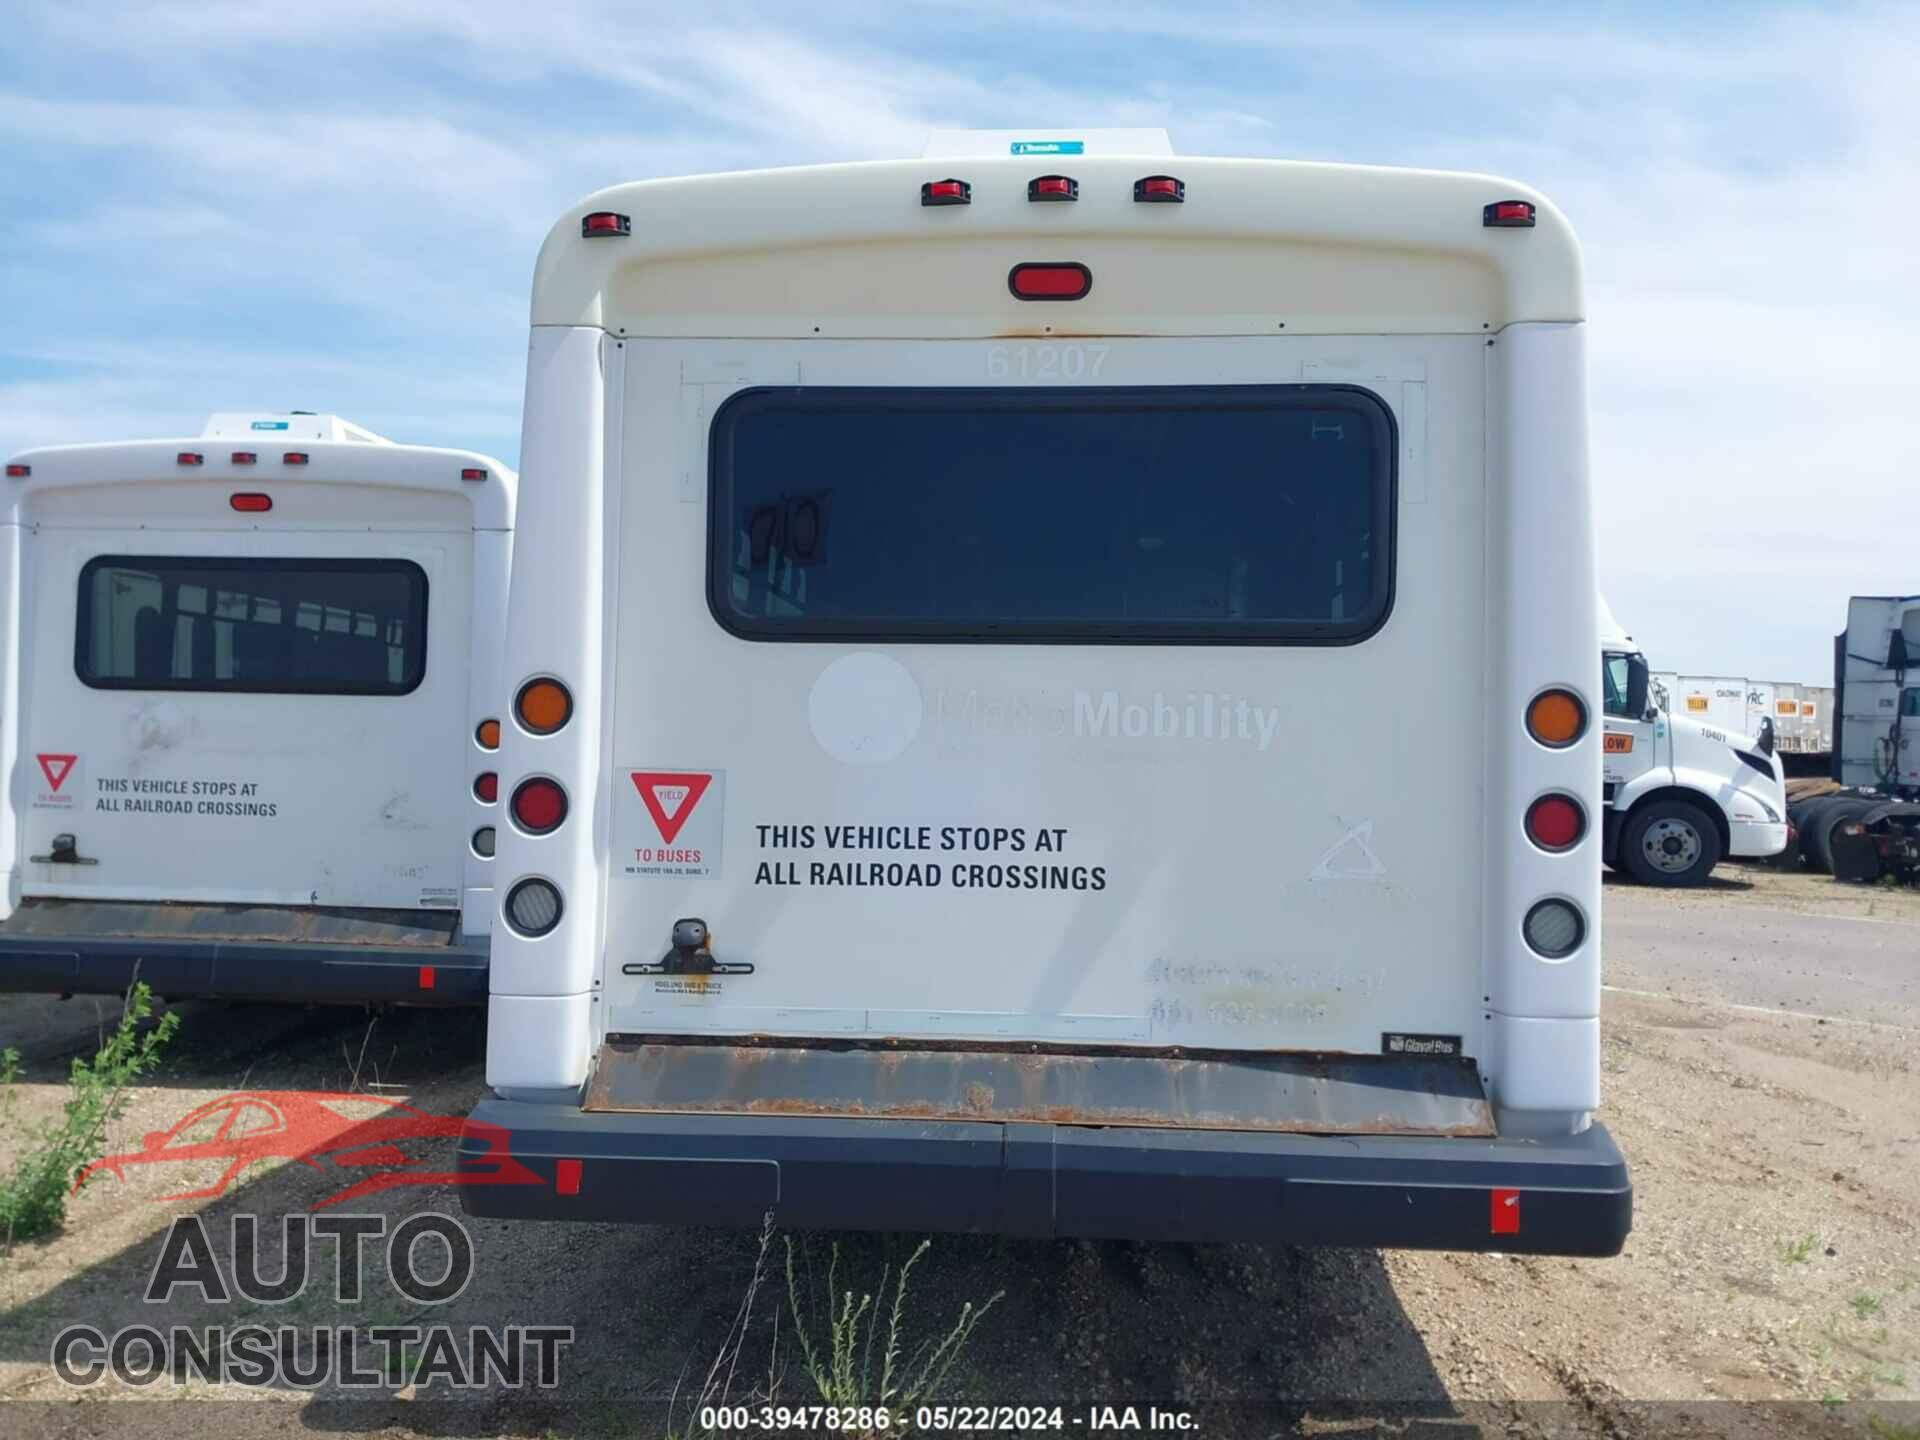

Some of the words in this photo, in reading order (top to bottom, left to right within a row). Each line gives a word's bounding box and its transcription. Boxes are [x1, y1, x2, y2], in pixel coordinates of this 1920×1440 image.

[987, 343, 1111, 377] 61207
[1073, 688, 1280, 752] Mobility
[1701, 727, 1727, 743] 10401
[97, 778, 128, 792] THIS
[132, 779, 188, 794] VEHICLE
[192, 781, 236, 796] STOPS
[240, 783, 258, 796] AT
[658, 791, 684, 800] YIELD
[95, 797, 120, 812] ALL
[124, 798, 193, 814] RAILROAD
[197, 800, 277, 817] CROSSINGS
[756, 825, 815, 848] THIS
[824, 826, 931, 850] VEHICLE
[940, 827, 1026, 852] STOPS
[1034, 828, 1068, 852] AT
[634, 848, 652, 862] TO
[657, 849, 701, 863] BUSES
[754, 862, 801, 885] ALL
[810, 862, 942, 887] RAILROAD
[951, 864, 1106, 891] CROSSINGS
[1435, 1040, 1454, 1054] Bus
